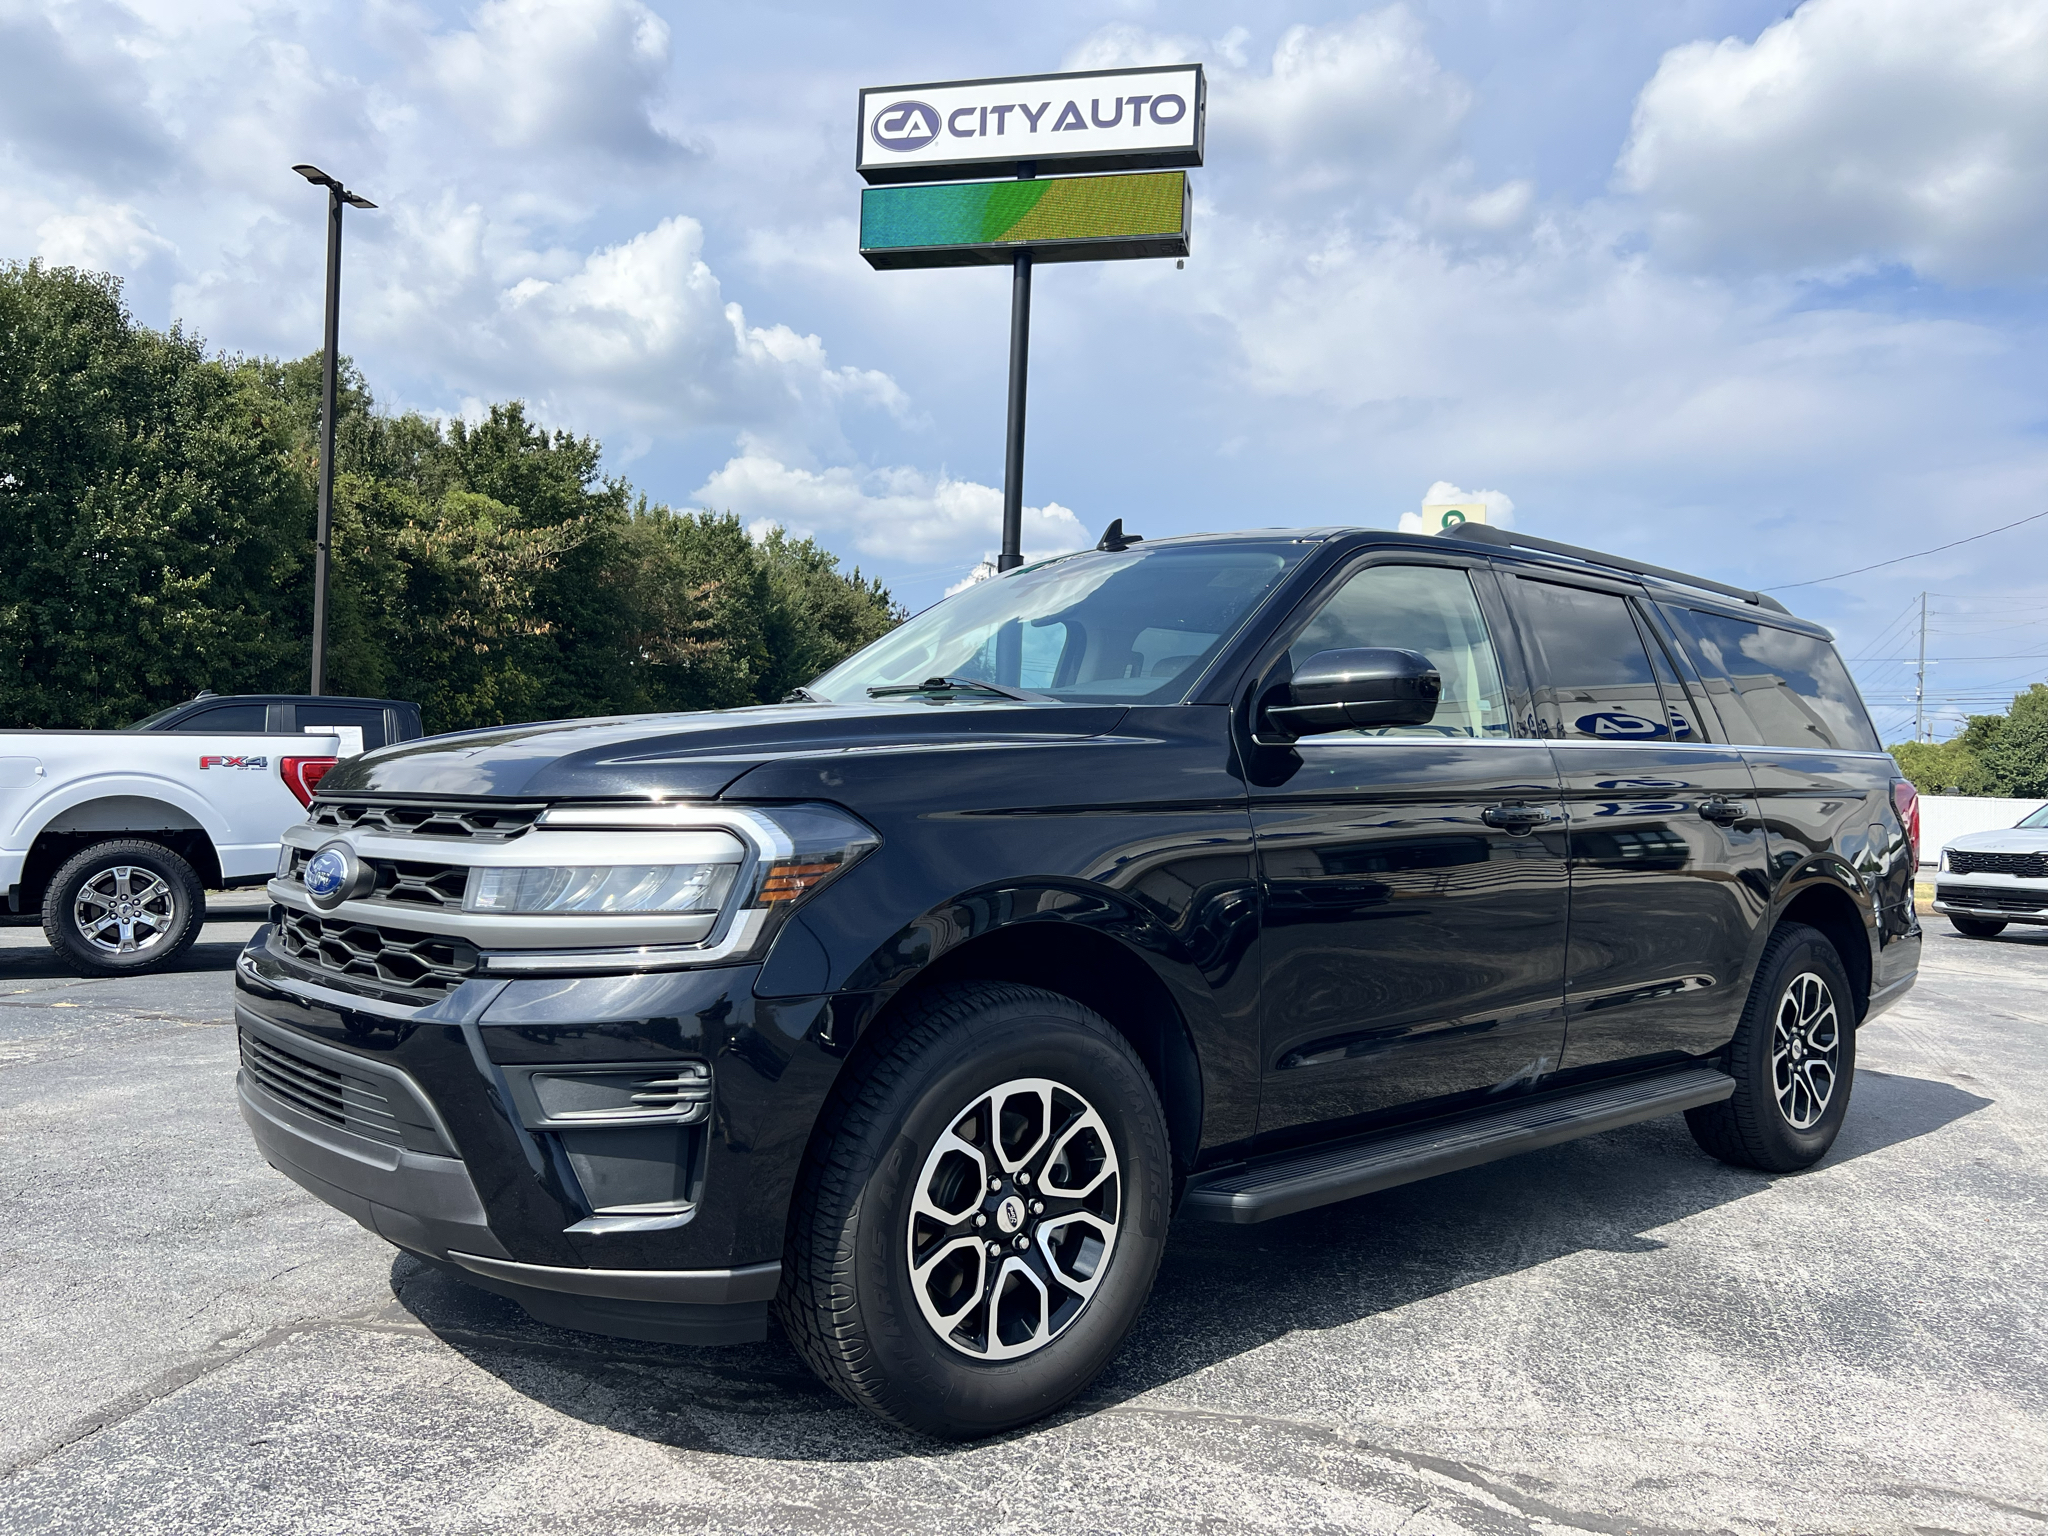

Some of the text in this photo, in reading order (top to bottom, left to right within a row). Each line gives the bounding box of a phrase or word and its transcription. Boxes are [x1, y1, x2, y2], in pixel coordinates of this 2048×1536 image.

[199, 755, 268, 770] FX4
[1104, 1062, 1163, 1228] STARFIRE
[879, 1148, 903, 1211] AP
